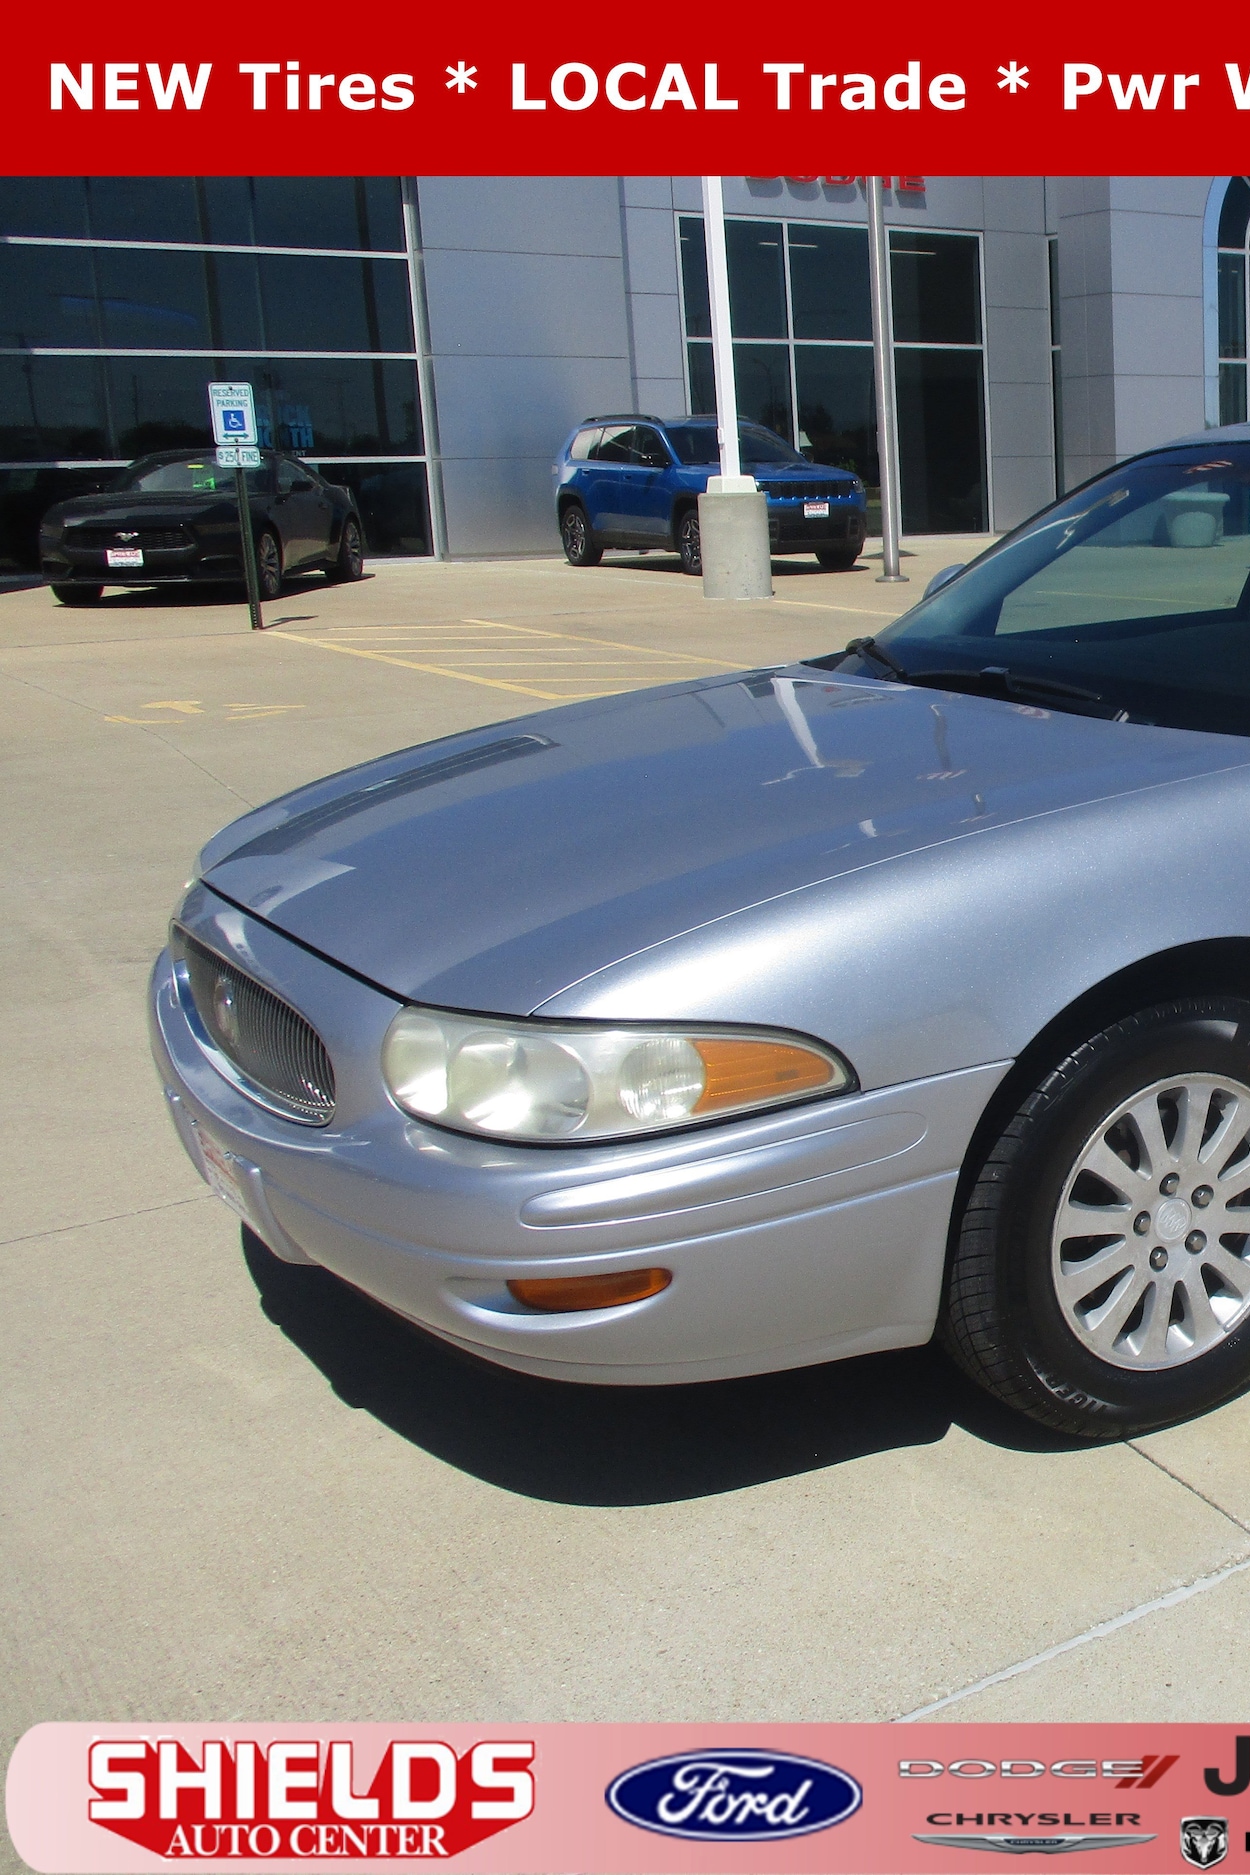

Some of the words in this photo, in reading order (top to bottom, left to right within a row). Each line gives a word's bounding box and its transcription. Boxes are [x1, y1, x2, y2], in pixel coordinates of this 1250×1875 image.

[212, 388, 249, 397] RESERVED
[216, 399, 249, 407] PARKING
[241, 451, 258, 462] FINE
